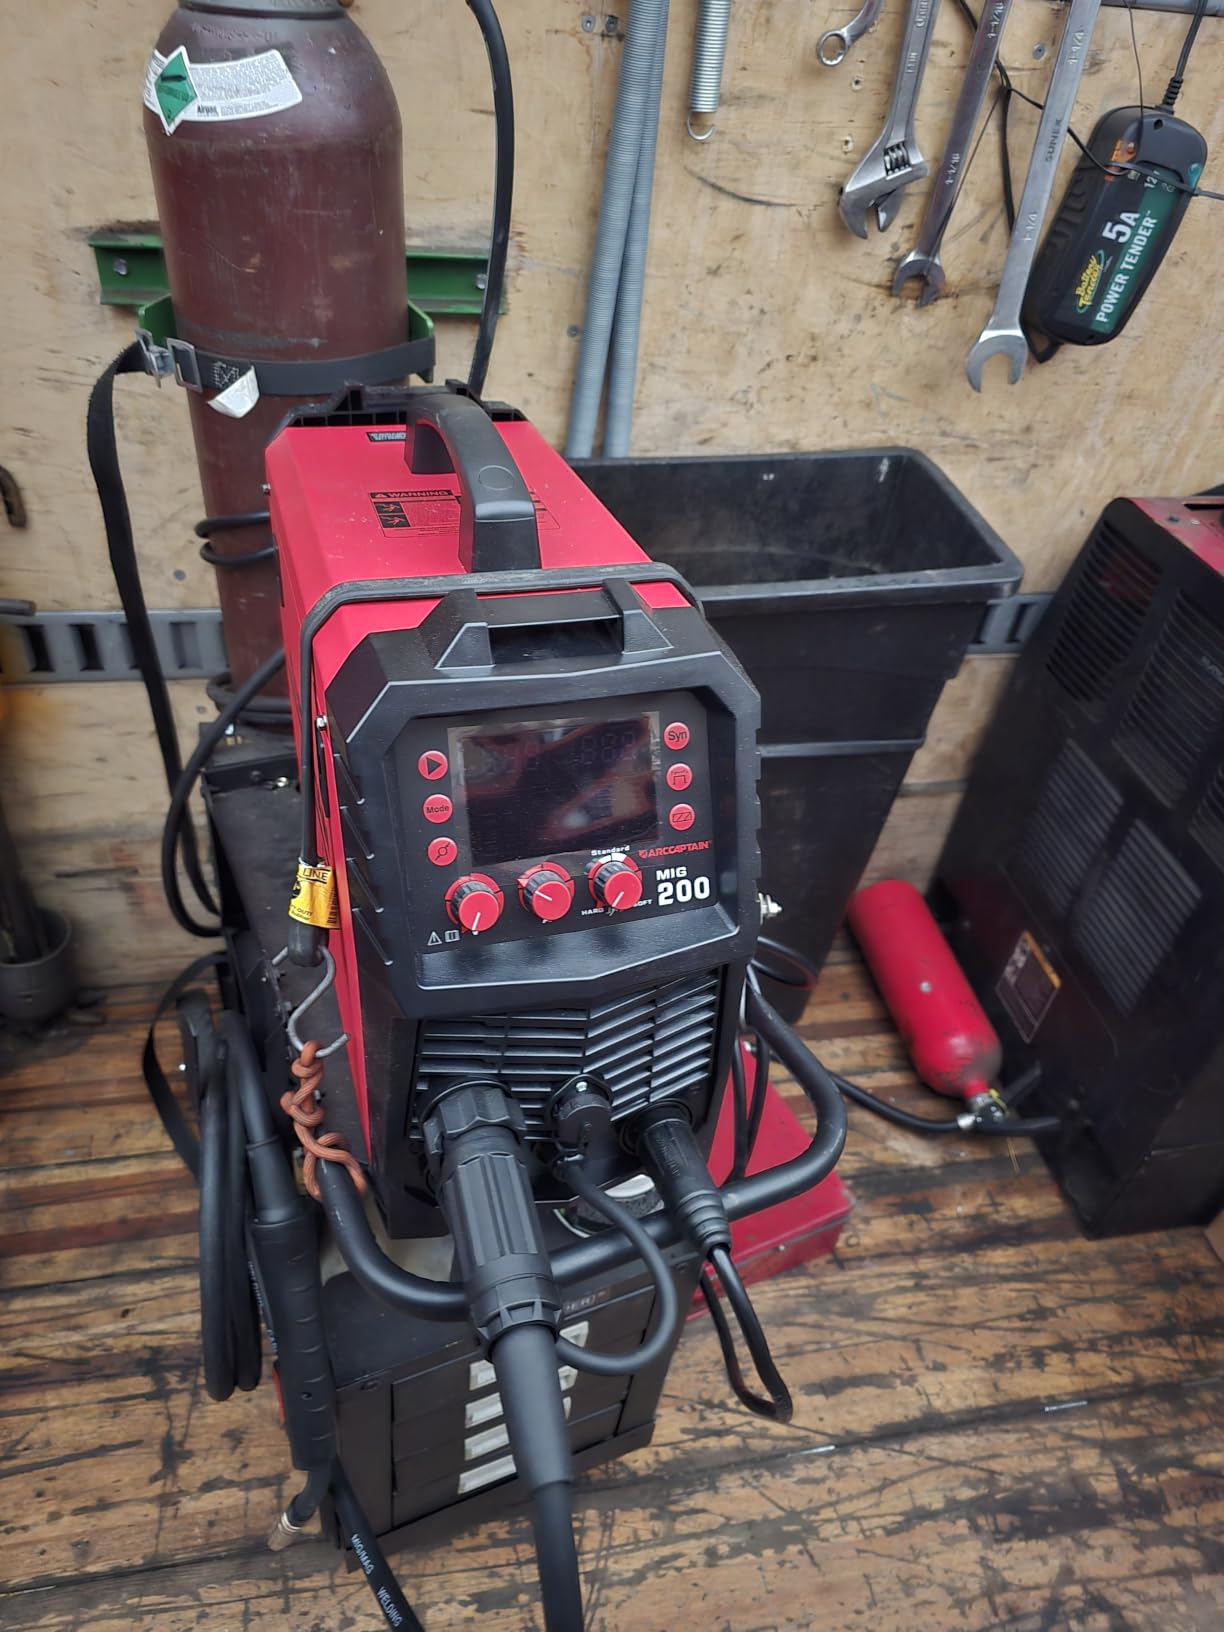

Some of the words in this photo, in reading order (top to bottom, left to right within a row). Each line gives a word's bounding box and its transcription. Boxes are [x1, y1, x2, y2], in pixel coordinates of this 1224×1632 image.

[1101, 210, 1141, 243] 5A
[1075, 254, 1099, 297] Battery
[1095, 273, 1130, 323] POWER
[1119, 218, 1158, 271] TENDER
[387, 490, 450, 498] WARNING
[667, 730, 688, 743] Syn
[426, 804, 450, 814] Mode
[590, 844, 631, 857] Standard
[648, 840, 710, 858] ARCCAPTAIN
[655, 866, 688, 881] MIG
[657, 875, 711, 906] 200
[377, 1586, 403, 1627] WELDING
